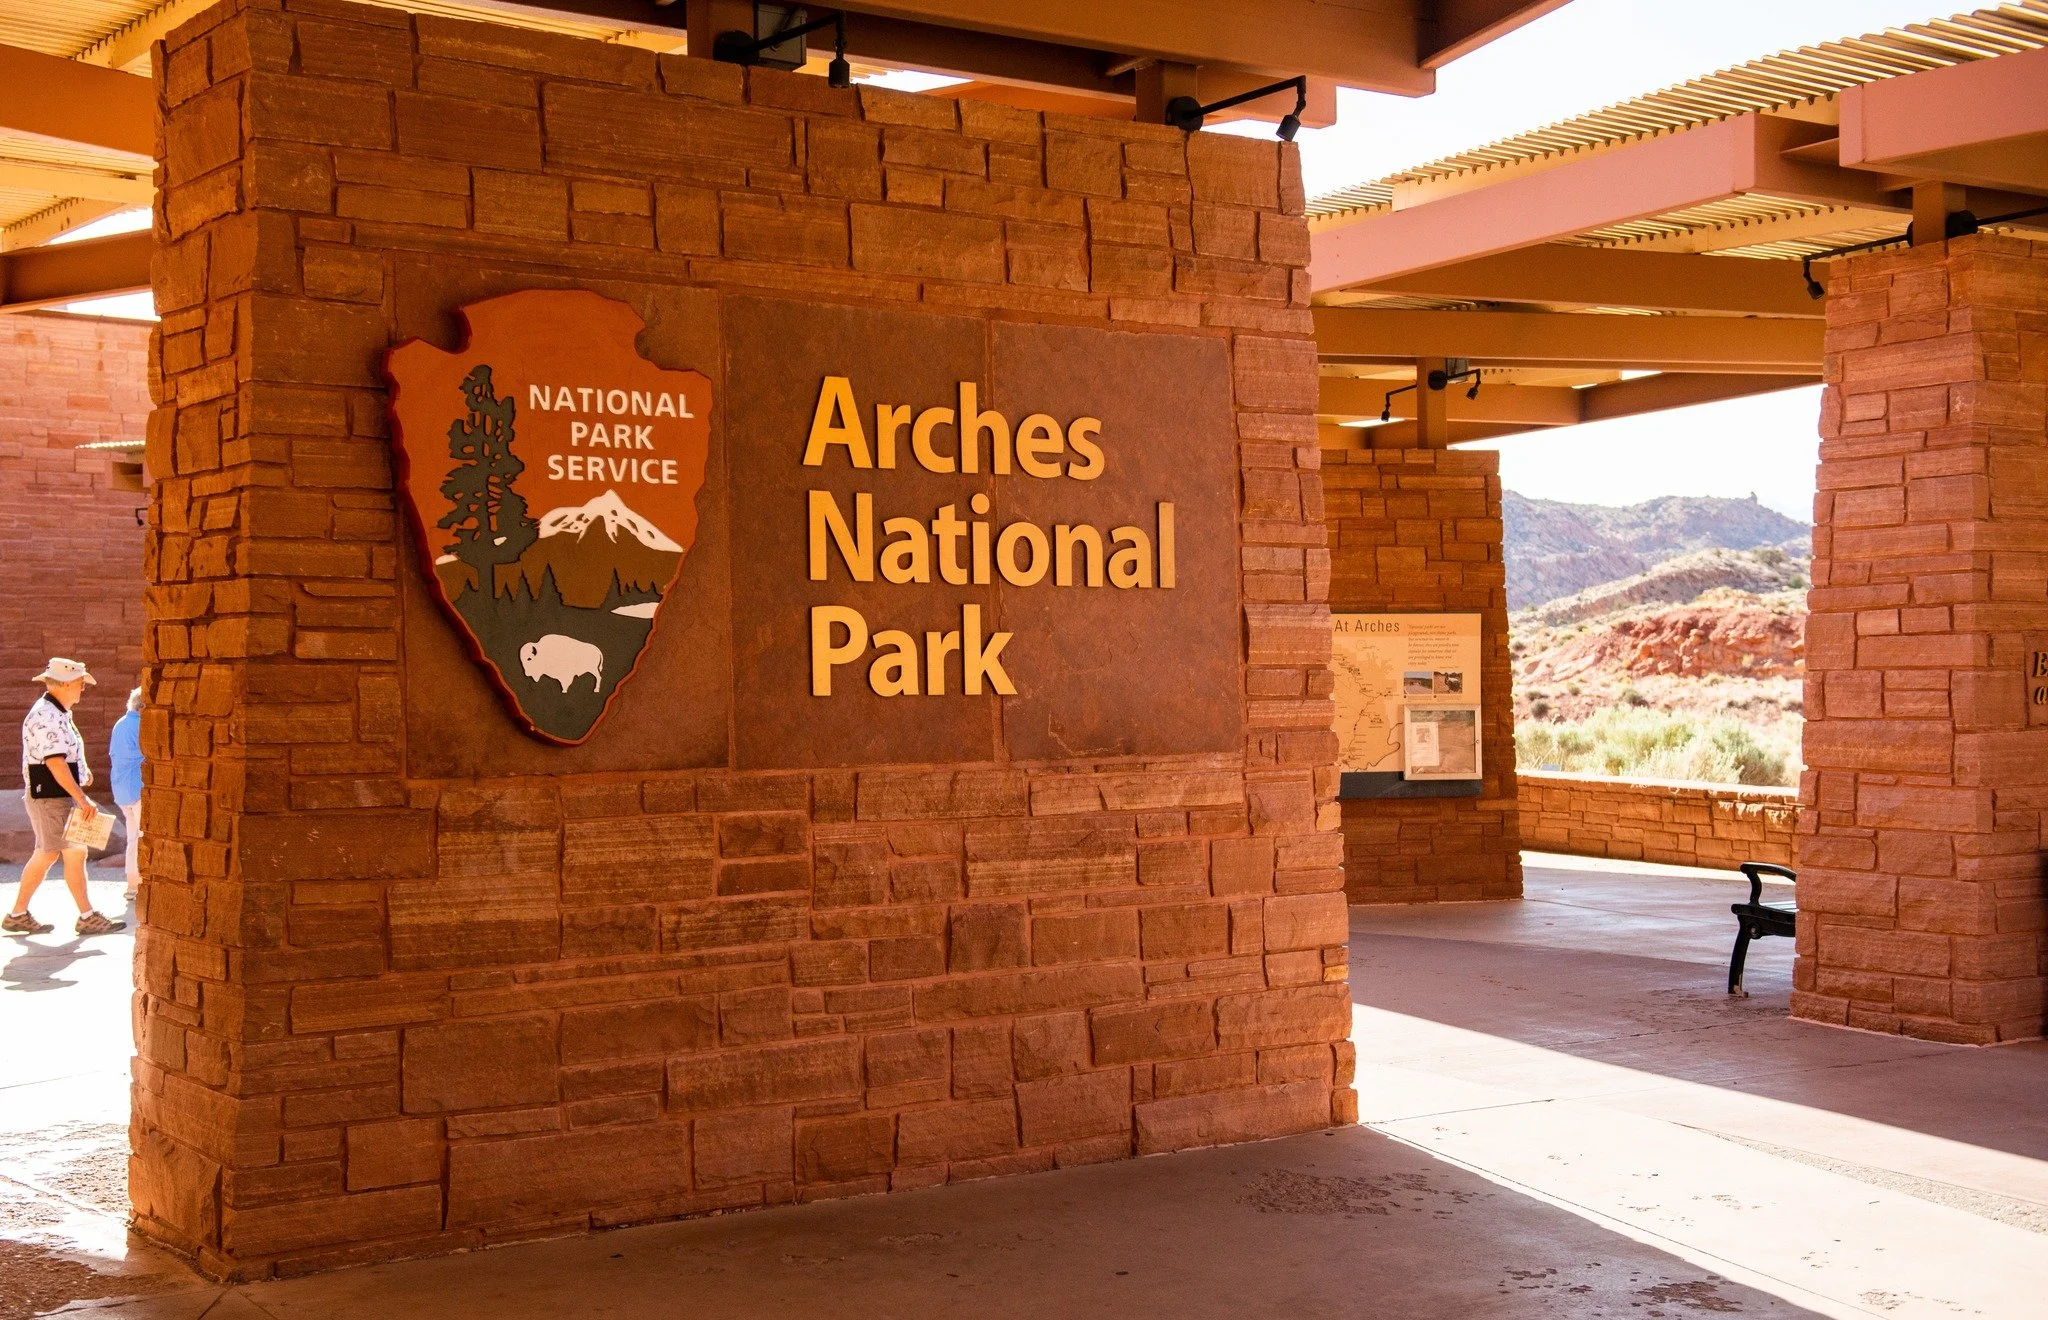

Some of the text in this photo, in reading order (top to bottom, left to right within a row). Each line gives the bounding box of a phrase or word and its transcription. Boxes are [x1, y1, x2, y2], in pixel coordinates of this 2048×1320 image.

[529, 384, 695, 419] NATIONAL
[571, 421, 655, 450] PARK
[802, 376, 1106, 481] Arches
[547, 454, 679, 485] SERVICE
[807, 490, 1177, 590] National
[1334, 619, 1349, 632] At
[1354, 619, 1400, 632] Arches
[811, 603, 1019, 697] Park
